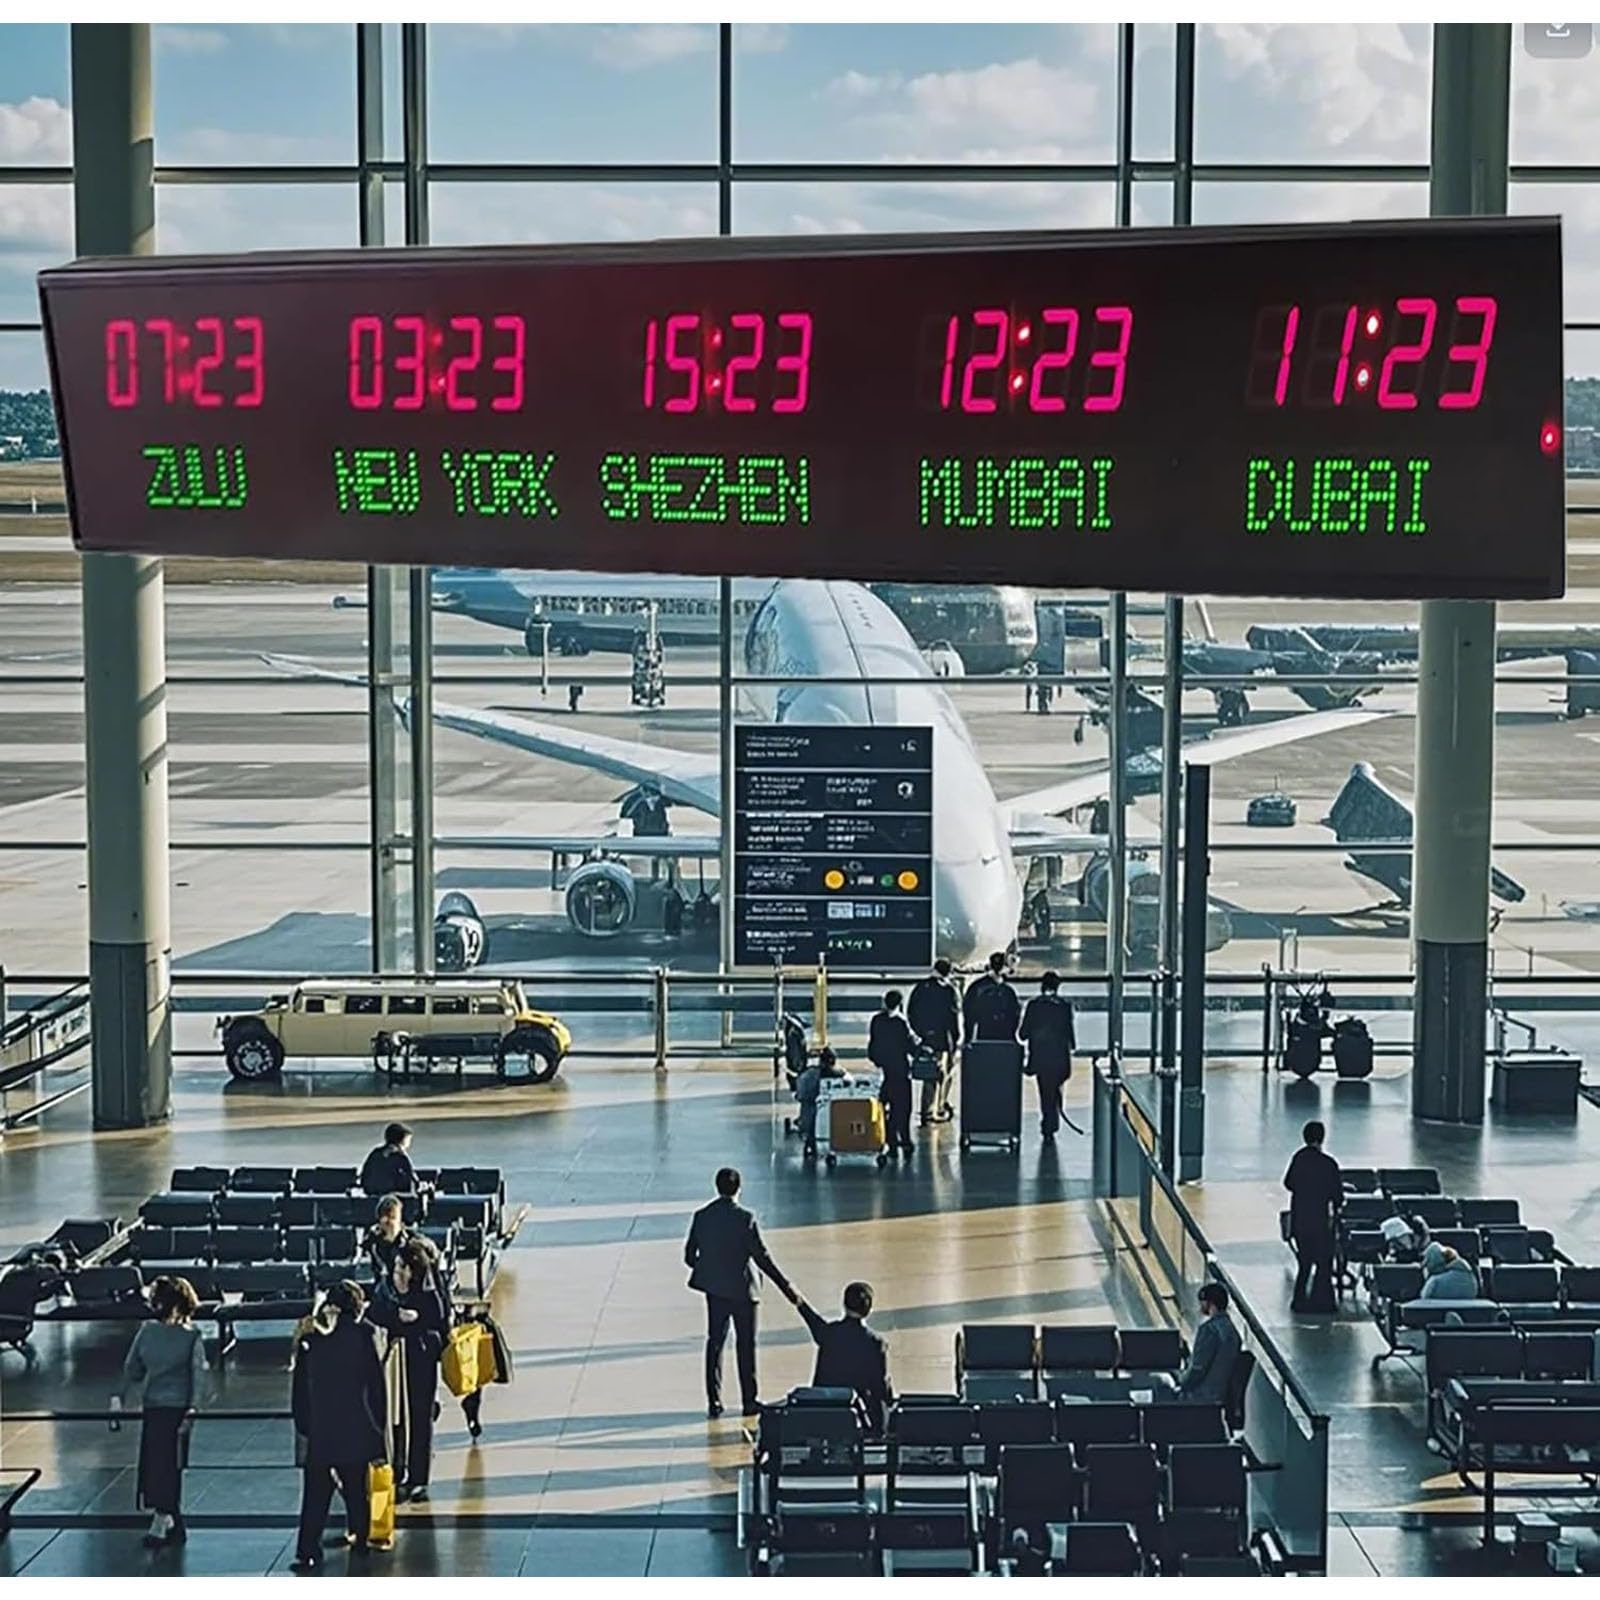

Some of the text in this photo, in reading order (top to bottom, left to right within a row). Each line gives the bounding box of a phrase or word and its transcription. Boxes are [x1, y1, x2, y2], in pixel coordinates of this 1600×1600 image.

[105, 317, 264, 407] 07:23
[348, 315, 525, 410] 03:23
[644, 313, 812, 412] 15:23
[941, 307, 1133, 413] 12:23
[1274, 297, 1498, 409] 11:23
[143, 446, 249, 509] ZULU
[335, 450, 559, 517] NEW YORK
[600, 454, 810, 523] SHEZHEN
[919, 458, 1113, 528] MUMBAI
[1245, 458, 1430, 534] DUBAI
